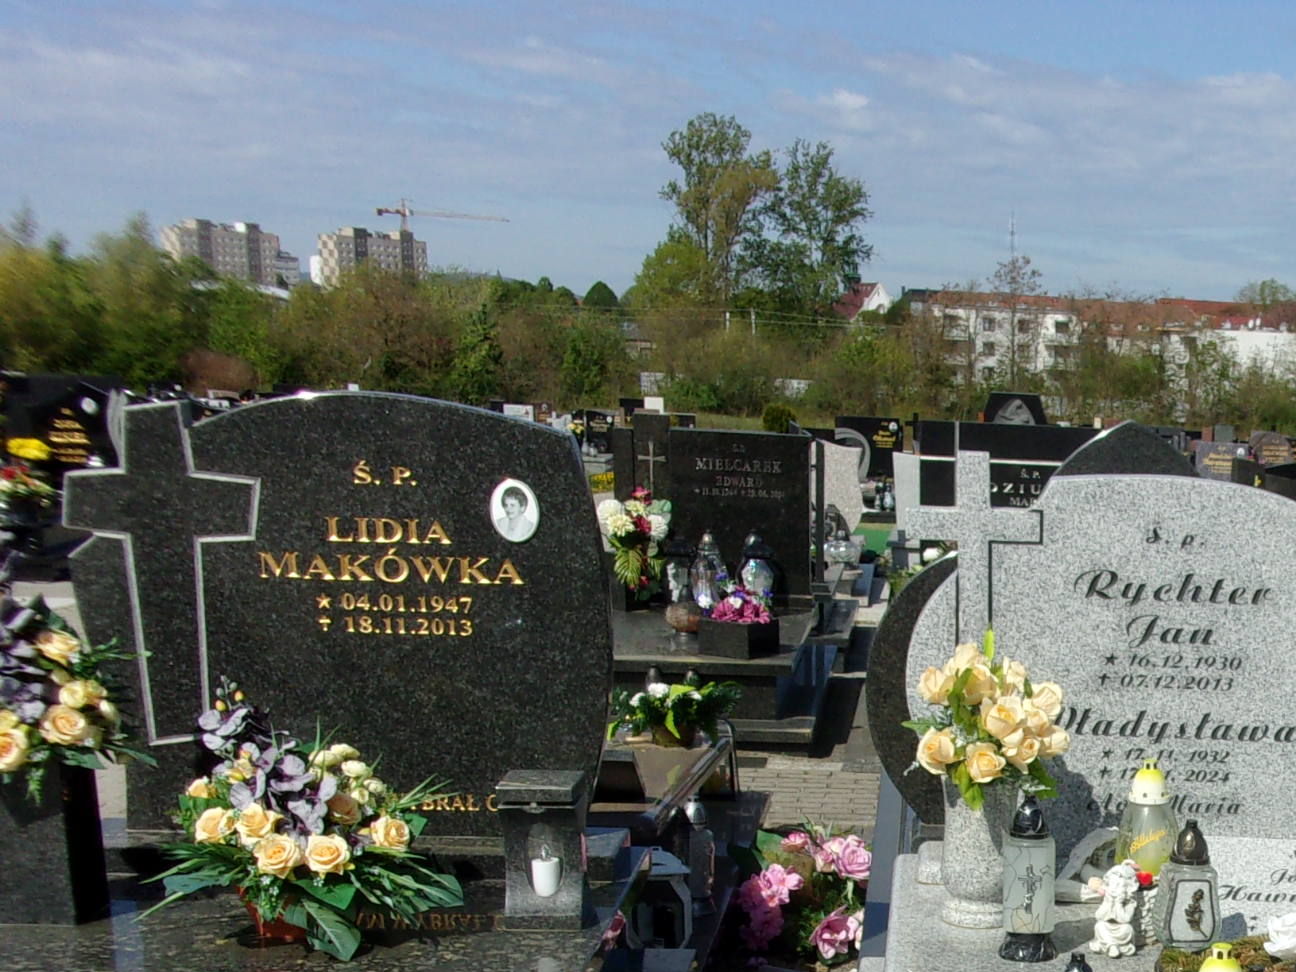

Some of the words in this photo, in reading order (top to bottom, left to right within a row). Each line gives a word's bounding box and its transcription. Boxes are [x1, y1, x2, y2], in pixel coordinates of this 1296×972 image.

[391, 466, 417, 487] P.
[325, 516, 452, 545] LIDIA
[258, 548, 525, 585] MAKÓWKA
[1073, 568, 1273, 606] Rychter
[341, 593, 473, 614] 04.01.1947
[344, 616, 474, 637] 18.11.2013
[1126, 614, 1215, 649] Jan
[1129, 653, 1243, 671] 16.12.1930
[1120, 672, 1235, 692] 07.12.2013
